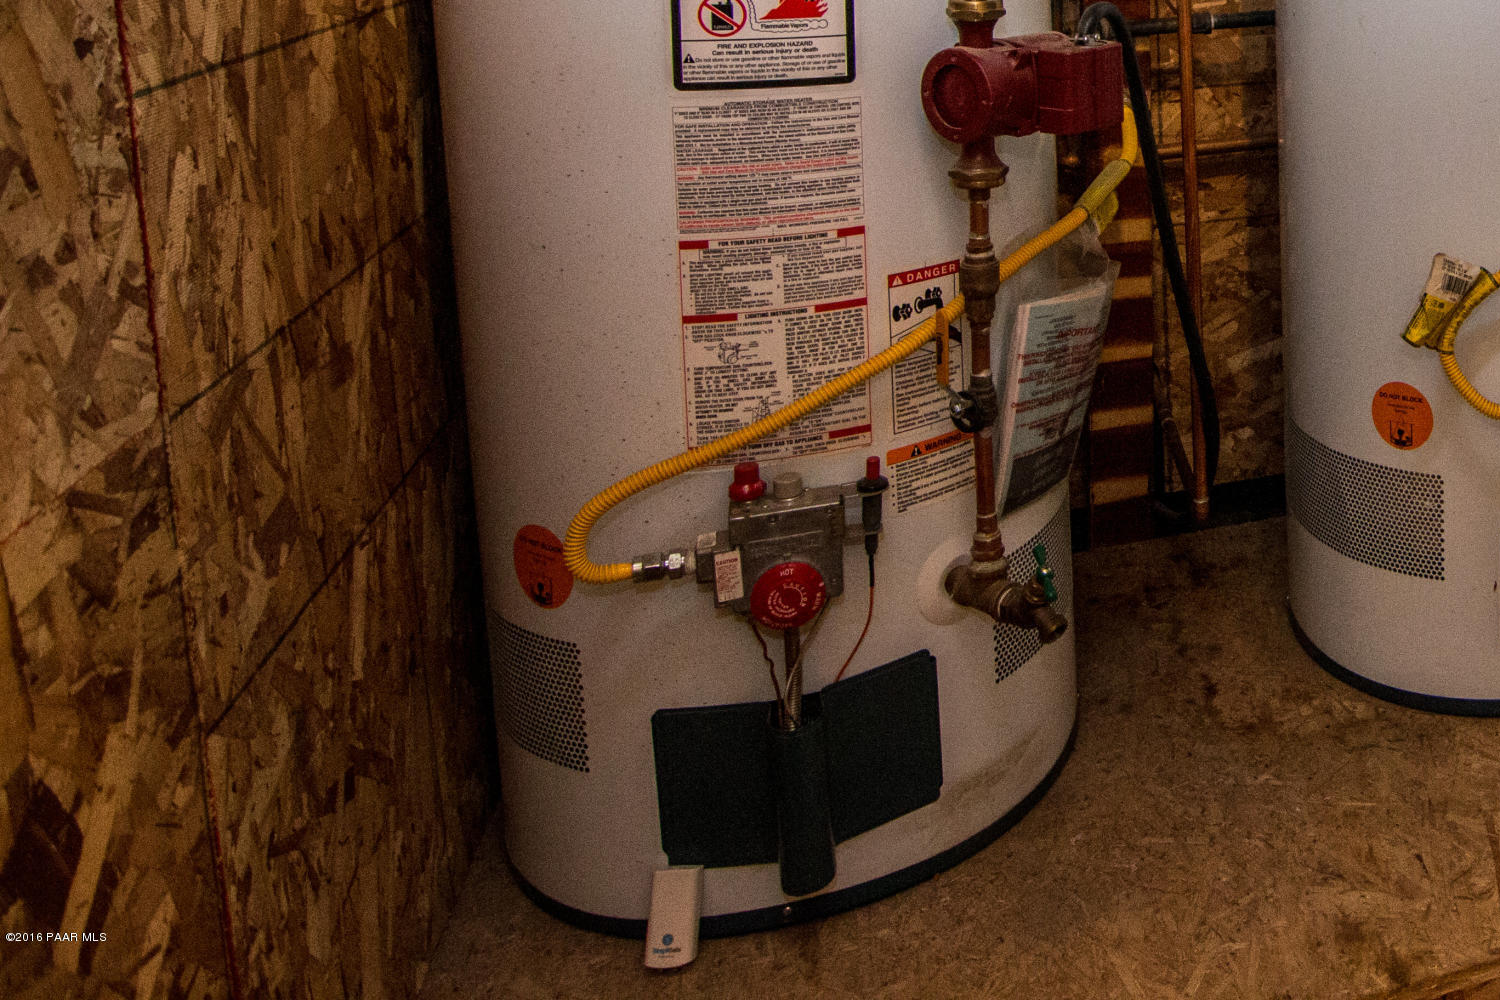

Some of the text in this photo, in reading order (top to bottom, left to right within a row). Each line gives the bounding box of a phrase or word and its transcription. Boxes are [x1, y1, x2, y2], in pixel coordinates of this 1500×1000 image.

[907, 264, 957, 282] DANGER
[770, 308, 808, 317] INSTRUCTIONS
[925, 432, 962, 451] WARNING
